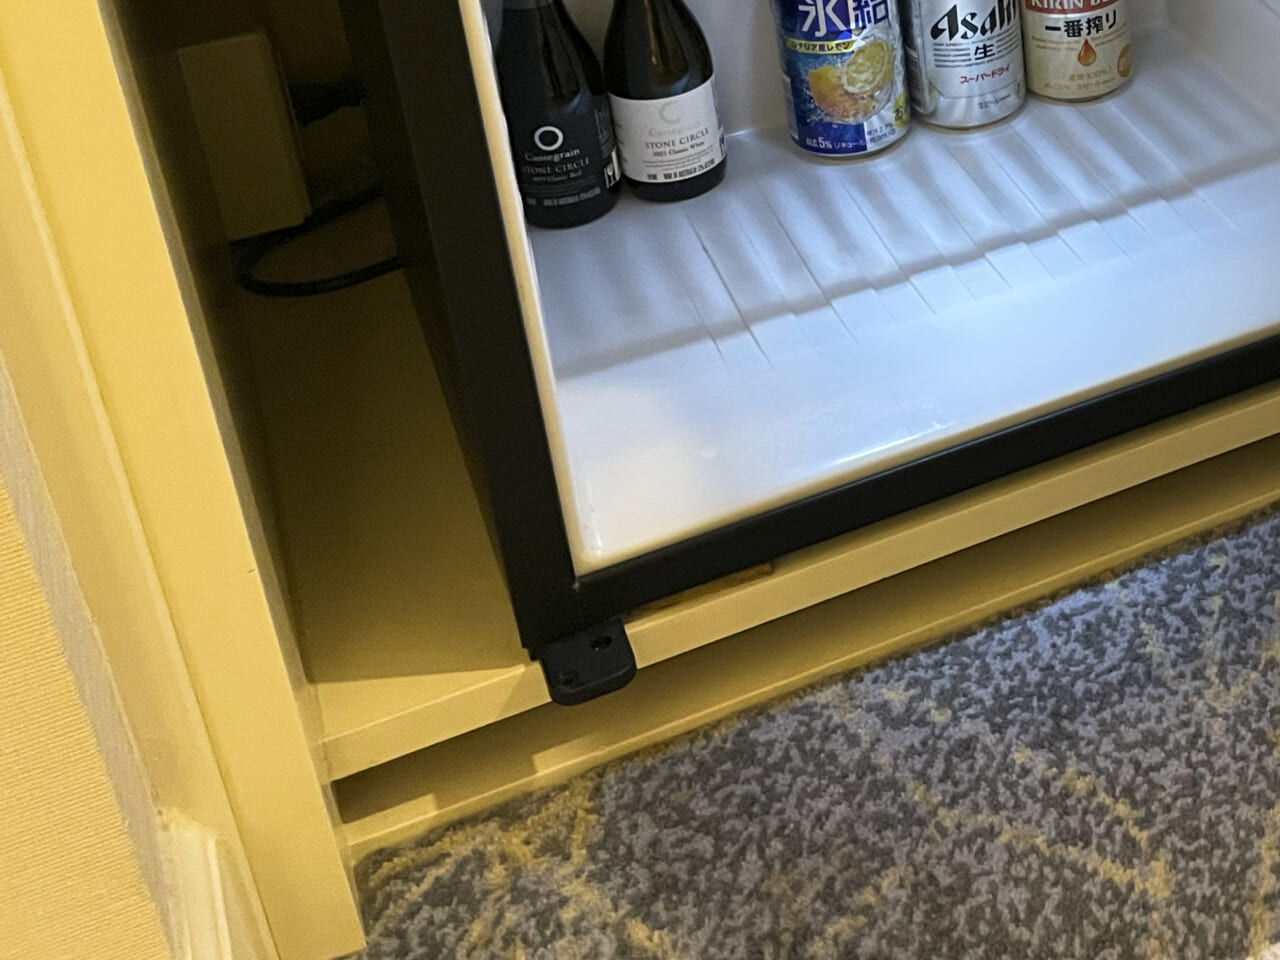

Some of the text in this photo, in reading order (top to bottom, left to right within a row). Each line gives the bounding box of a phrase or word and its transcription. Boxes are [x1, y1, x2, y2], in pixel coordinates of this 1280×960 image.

[1044, 9, 1117, 39] 一番搾り
[974, 43, 995, 61] 生
[645, 139, 675, 150] STONE
[679, 127, 709, 145] CIRCLE
